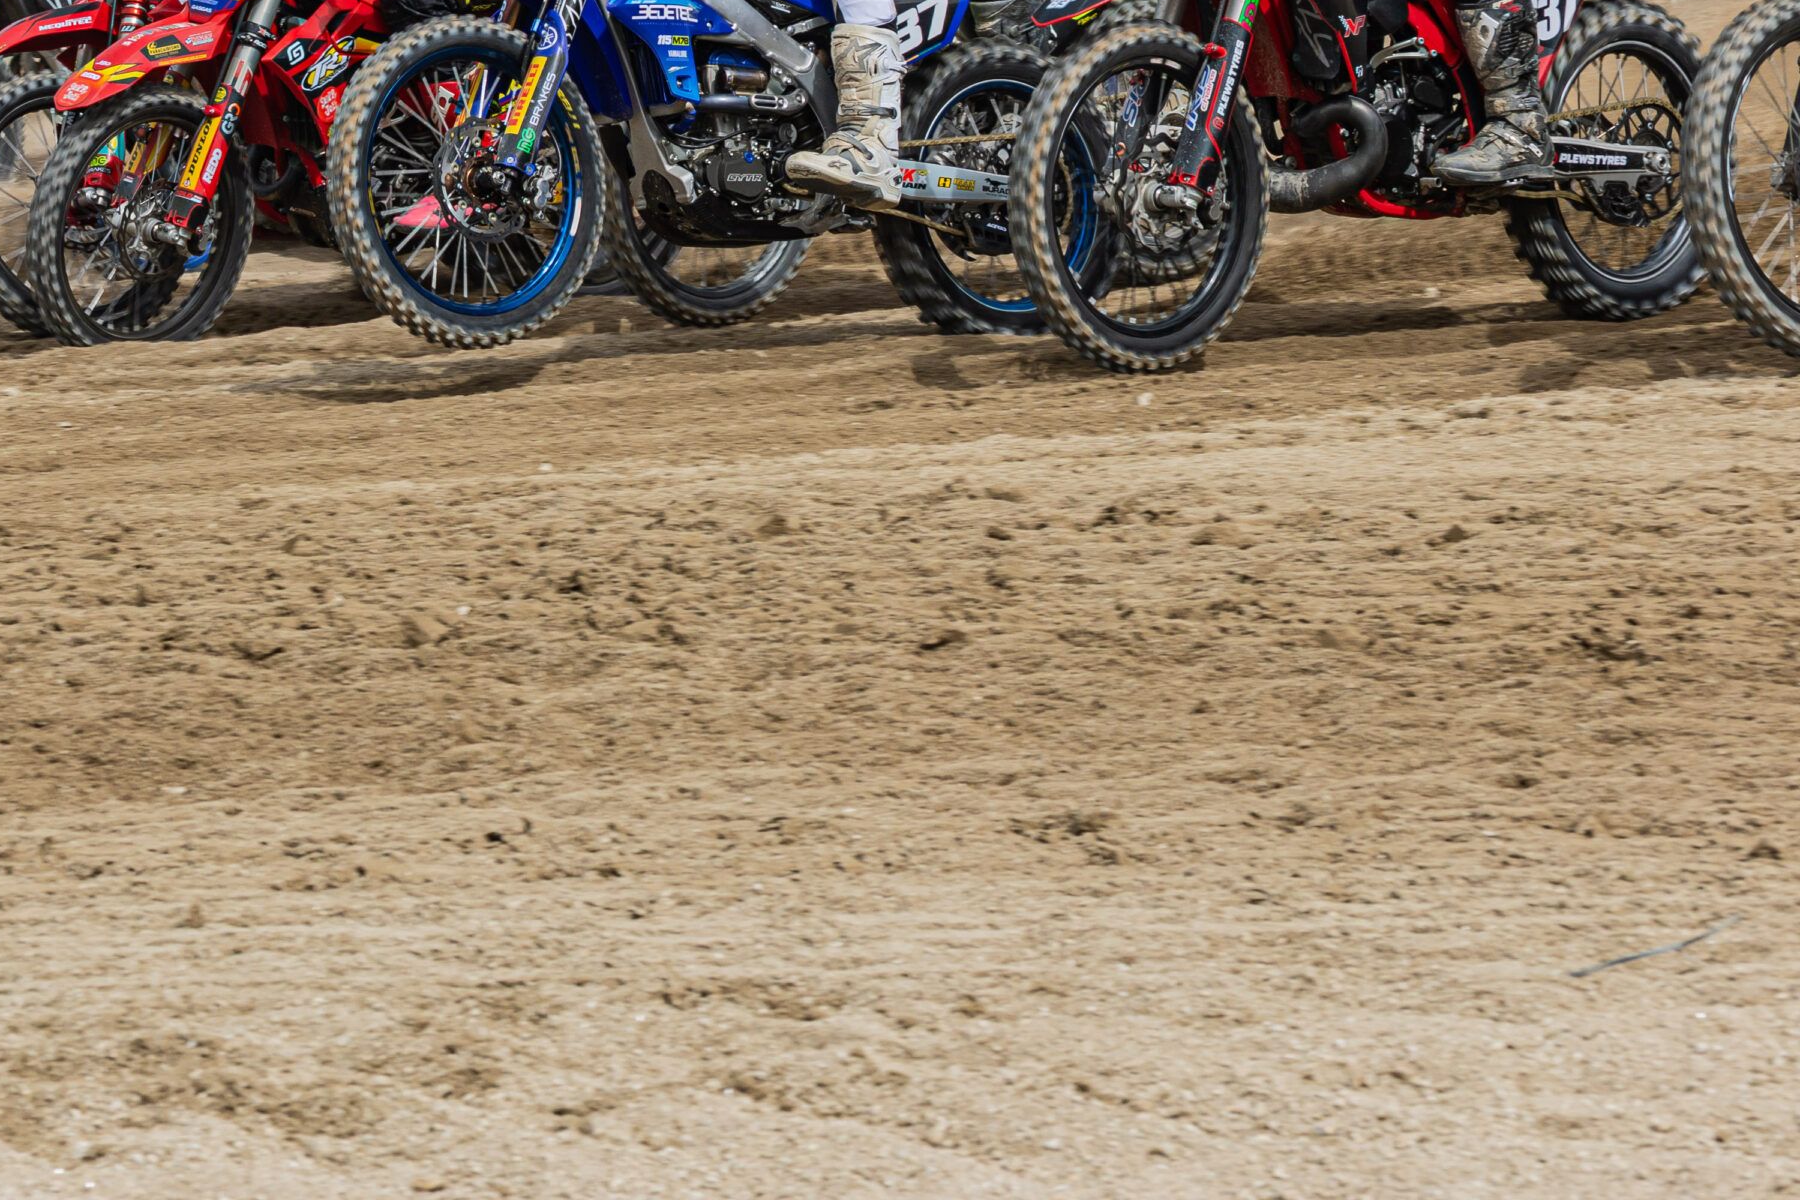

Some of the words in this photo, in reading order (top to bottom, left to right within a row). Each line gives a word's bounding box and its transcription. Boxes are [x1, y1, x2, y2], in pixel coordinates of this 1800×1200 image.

[506, 61, 540, 128] PIRELLI
[1216, 76, 1236, 118] PLEWS
[1229, 39, 1245, 76] TYRES
[531, 72, 557, 128] BRAKES
[202, 148, 223, 184] REDD
[1558, 152, 1595, 166] PLEWS
[1595, 154, 1628, 167] TYRES
[726, 173, 763, 183] GYTR
[902, 182, 927, 190] AIN
